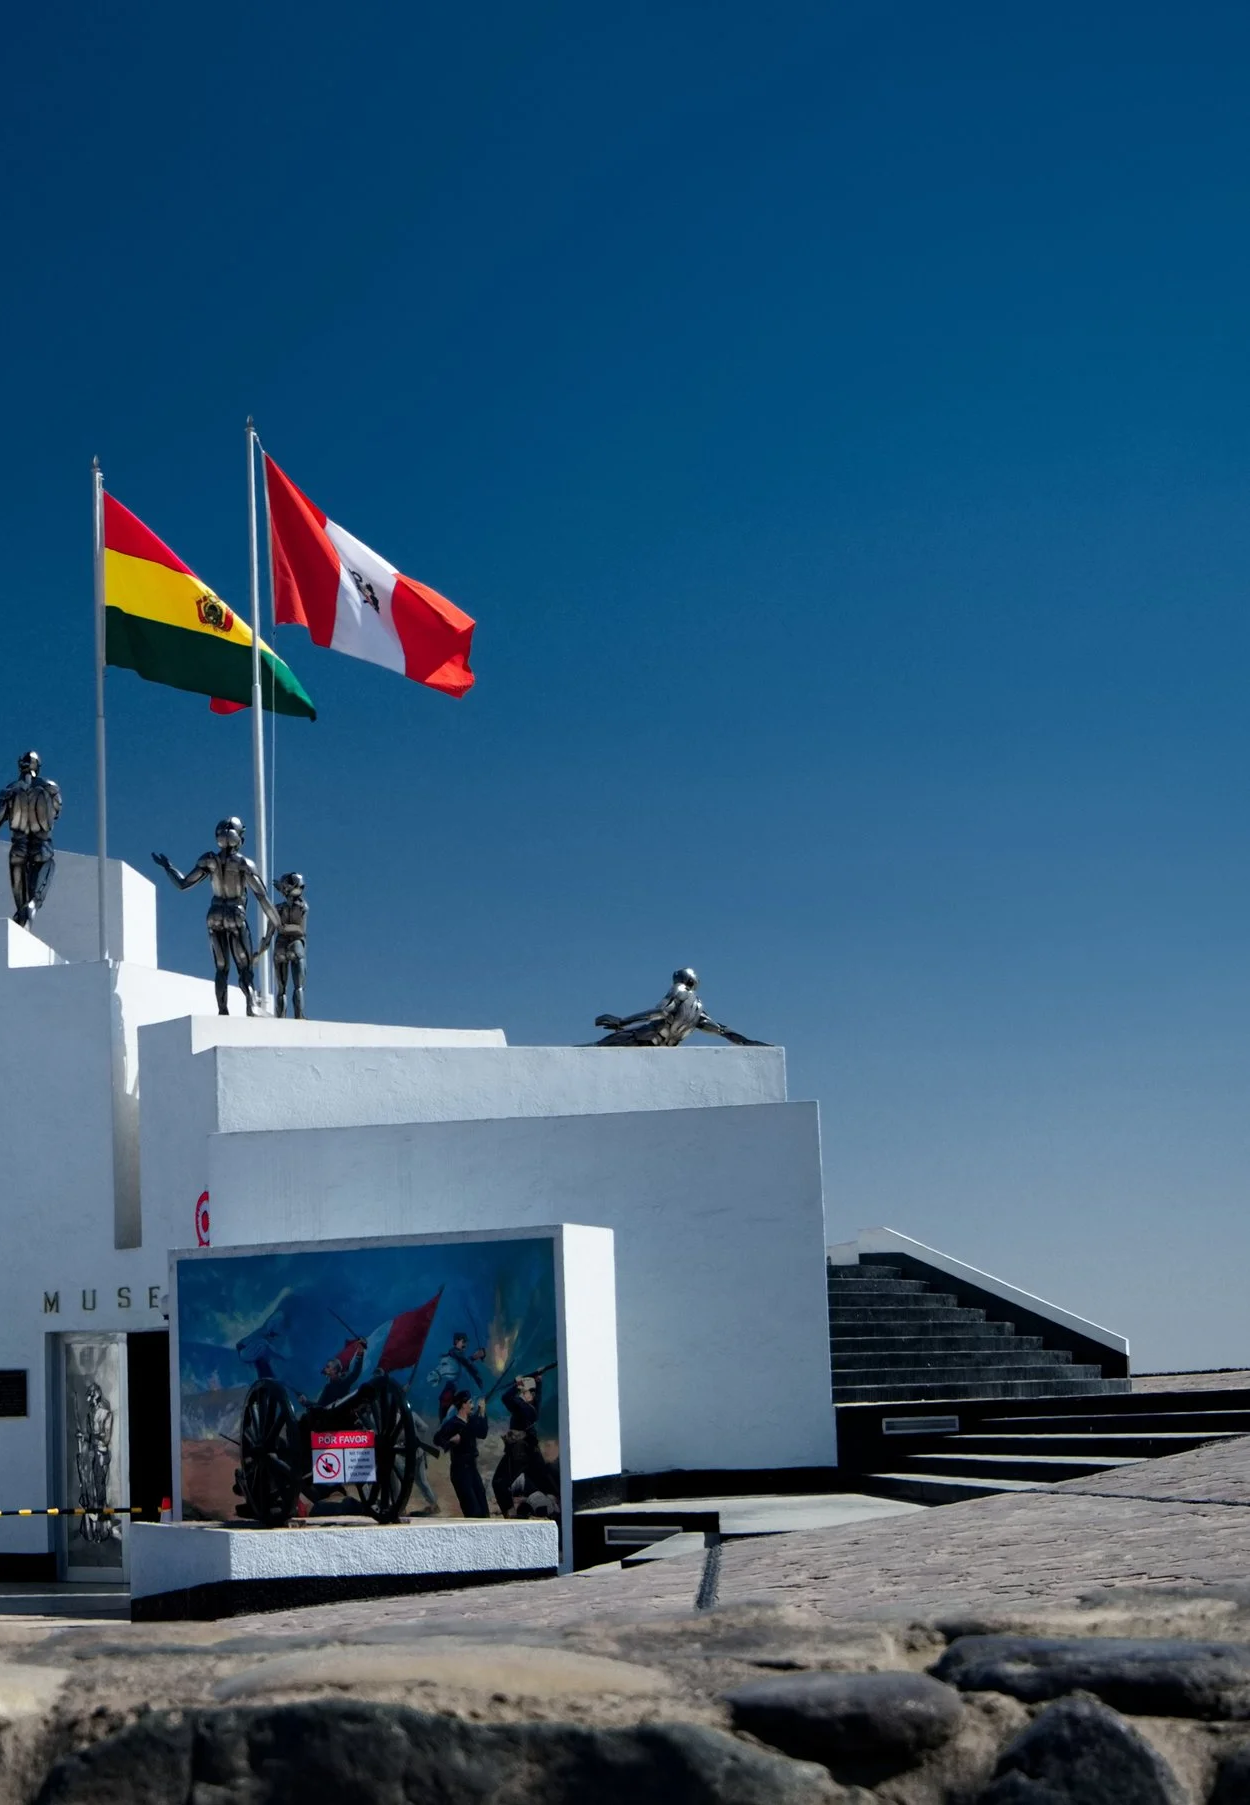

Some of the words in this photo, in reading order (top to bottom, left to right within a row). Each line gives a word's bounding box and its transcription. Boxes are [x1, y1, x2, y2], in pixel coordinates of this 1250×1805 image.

[43, 1286, 161, 1313] MUSE
[318, 1436, 337, 1444] POR
[339, 1435, 368, 1444] FAVOR
